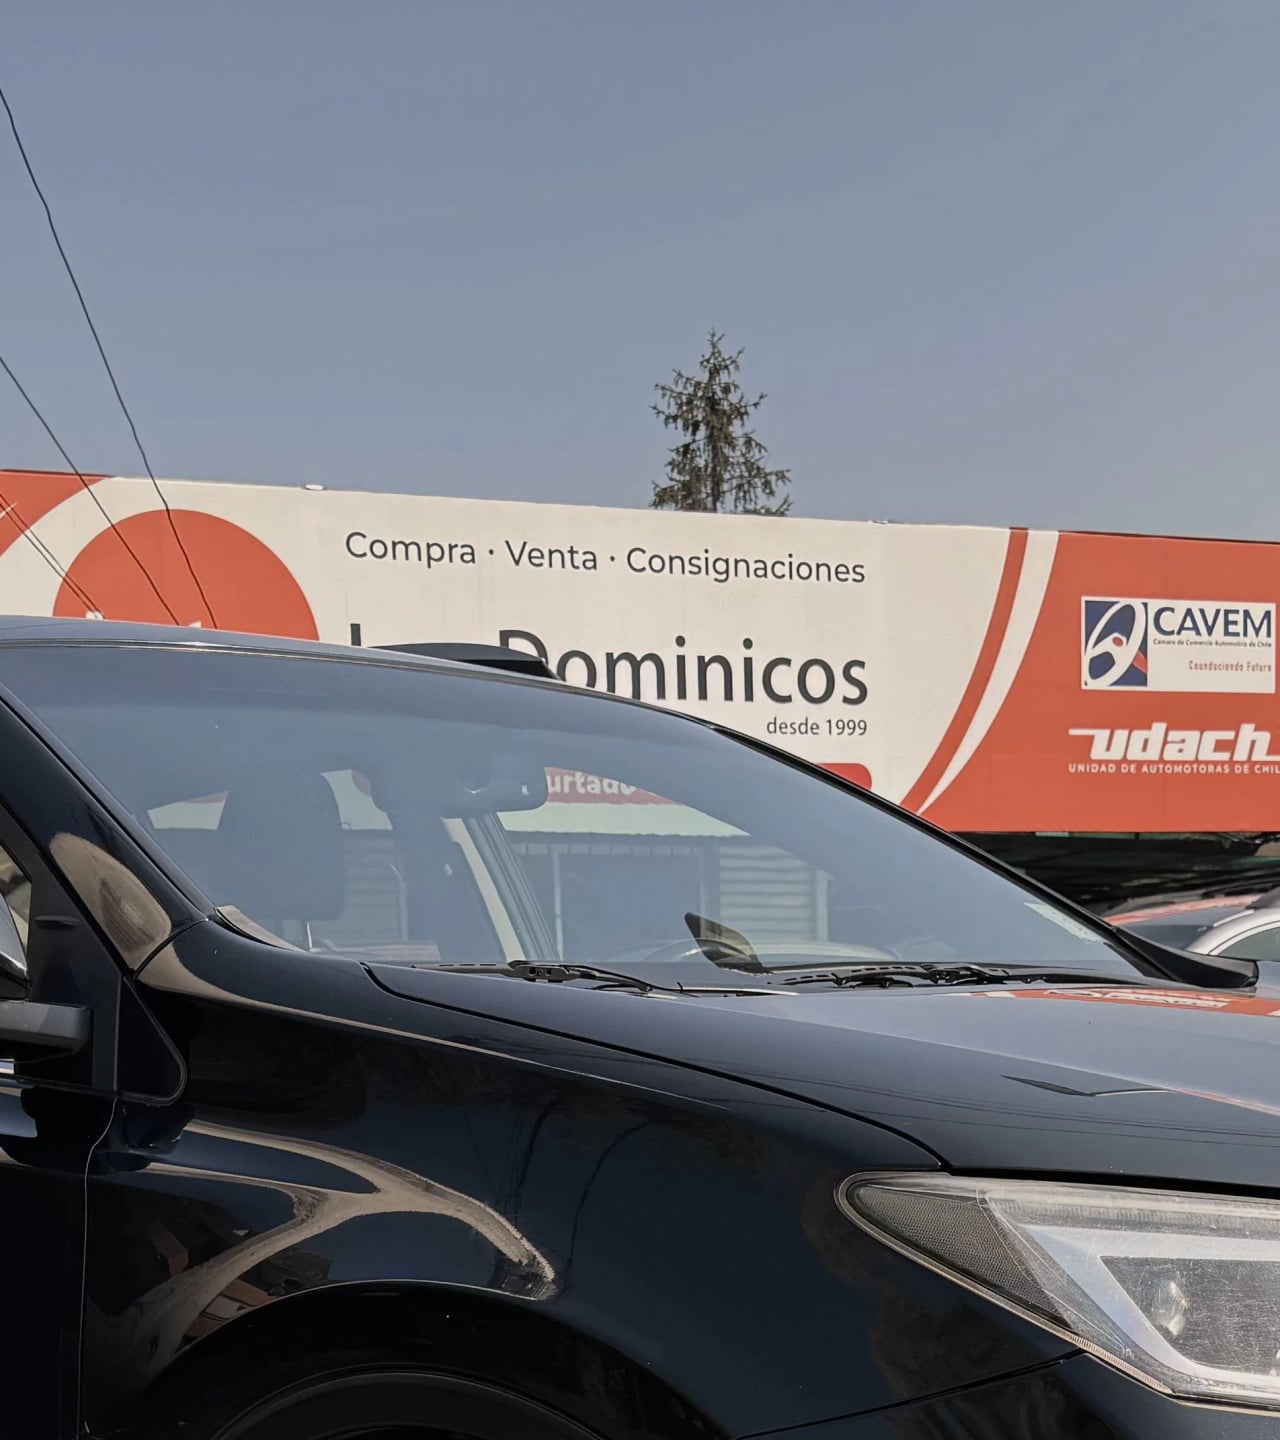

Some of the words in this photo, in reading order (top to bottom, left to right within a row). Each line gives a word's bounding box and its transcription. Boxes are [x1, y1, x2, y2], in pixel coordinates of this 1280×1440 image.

[345, 531, 477, 568] Compra
[505, 541, 598, 570] Venta
[626, 547, 866, 583] Consignaciones
[1153, 606, 1272, 639] CAVEM
[766, 716, 819, 735] desde
[825, 718, 867, 736] 1999
[1068, 763, 1116, 773] UNIDAD
[1121, 763, 1137, 773] DE
[1141, 764, 1230, 774] AUTOMOTORAS
[1234, 764, 1250, 774] DE
